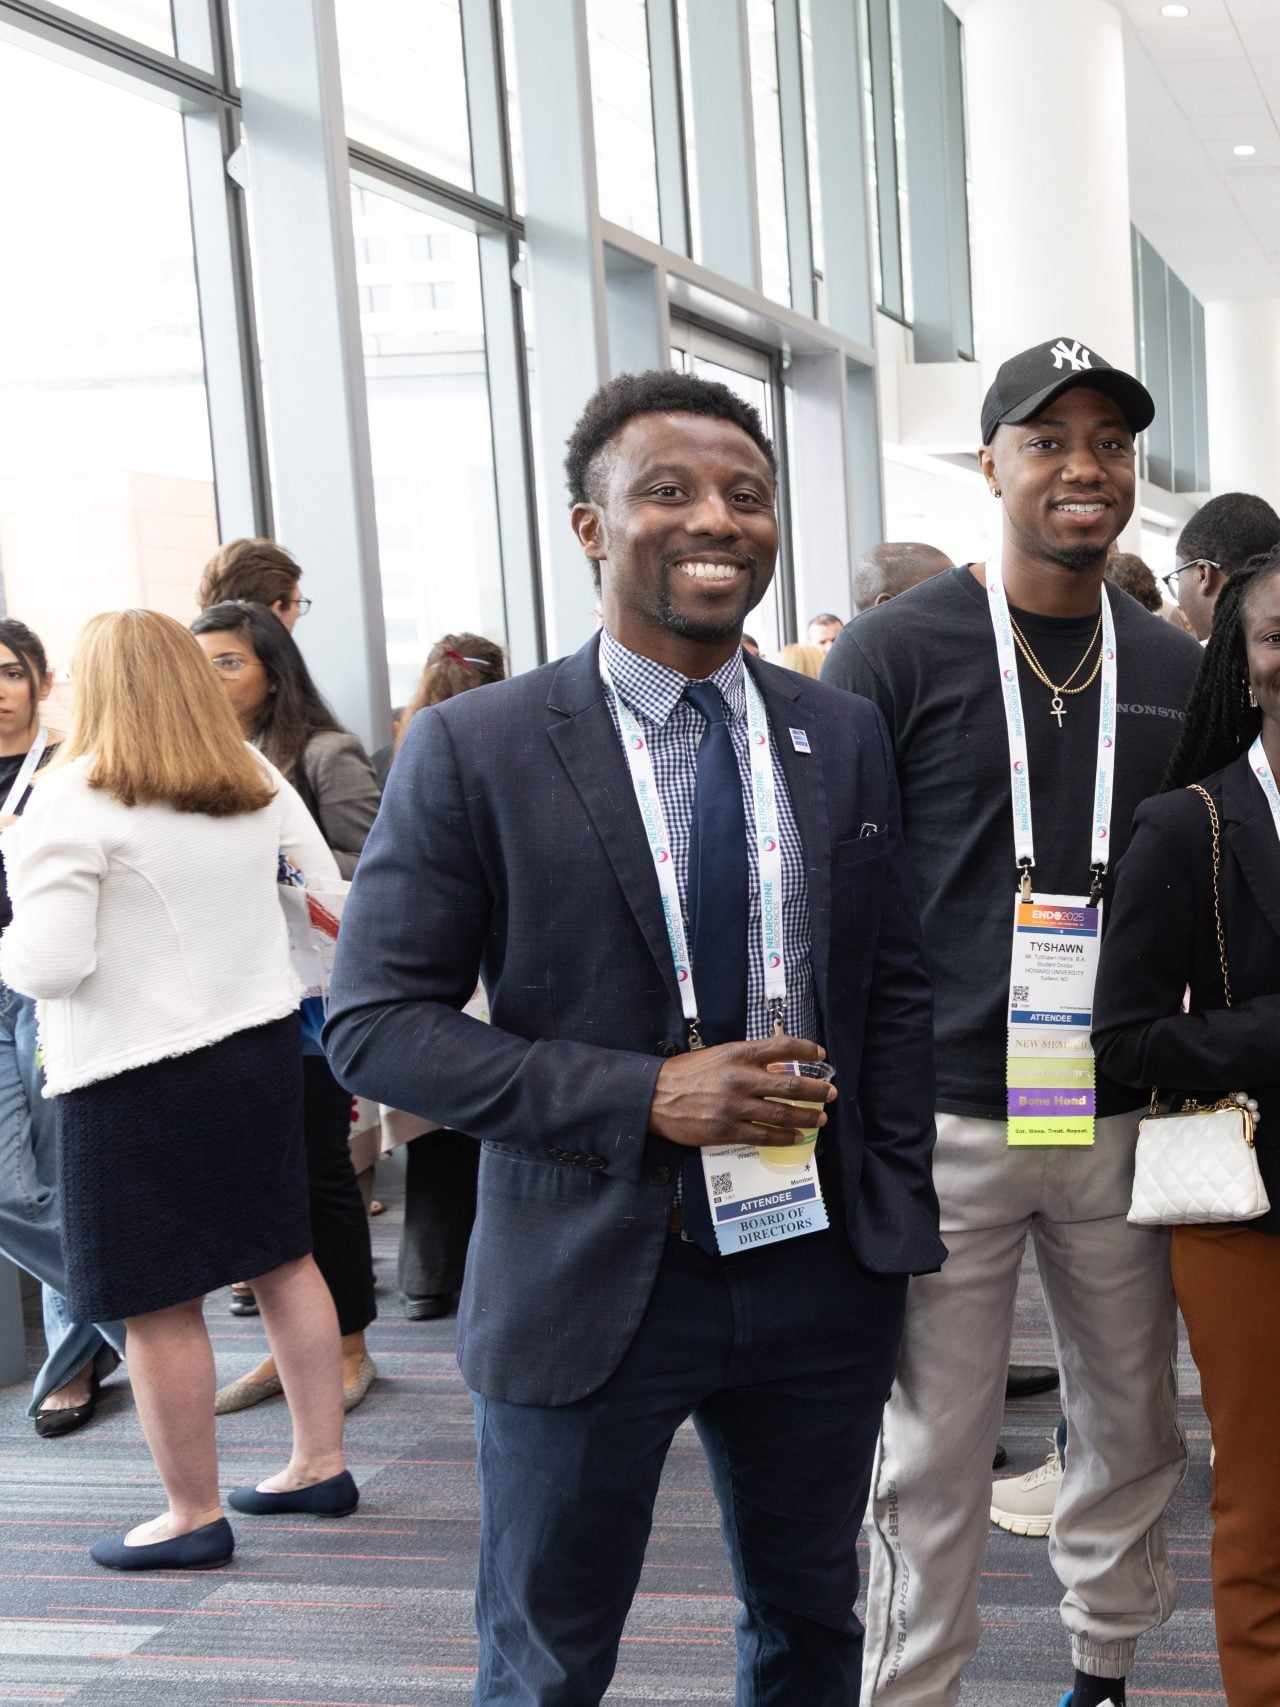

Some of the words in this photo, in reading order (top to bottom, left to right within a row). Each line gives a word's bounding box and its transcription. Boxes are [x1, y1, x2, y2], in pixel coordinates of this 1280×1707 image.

[1010, 684, 1023, 737] NEUROCRINE
[1102, 681, 1110, 737] NEUROCRINE
[637, 778, 659, 845] NEUROCRINE
[755, 771, 769, 833] NEUROCRINE
[1019, 777, 1029, 833] NEUROCRINE
[1096, 768, 1106, 824] NEUROCRINE
[672, 912, 687, 962] BIOSCIENCES
[763, 879, 774, 950] NEUROCRINE
[773, 900, 781, 950] BIOSCIENCES
[1029, 941, 1084, 954] TYSHAWN
[1030, 1013, 1072, 1022] ATTENDEE
[1016, 1040, 1039, 1048] NEW
[1054, 1095, 1087, 1105] Head
[740, 1191, 793, 1212] ATTENDEE
[791, 1177, 814, 1186] Member
[738, 1217, 813, 1245] DIRECTORS
[740, 1212, 785, 1232] BOARD
[788, 1206, 806, 1220] OF
[888, 1480, 898, 1536] FATHER
[897, 1609, 906, 1630] MY
